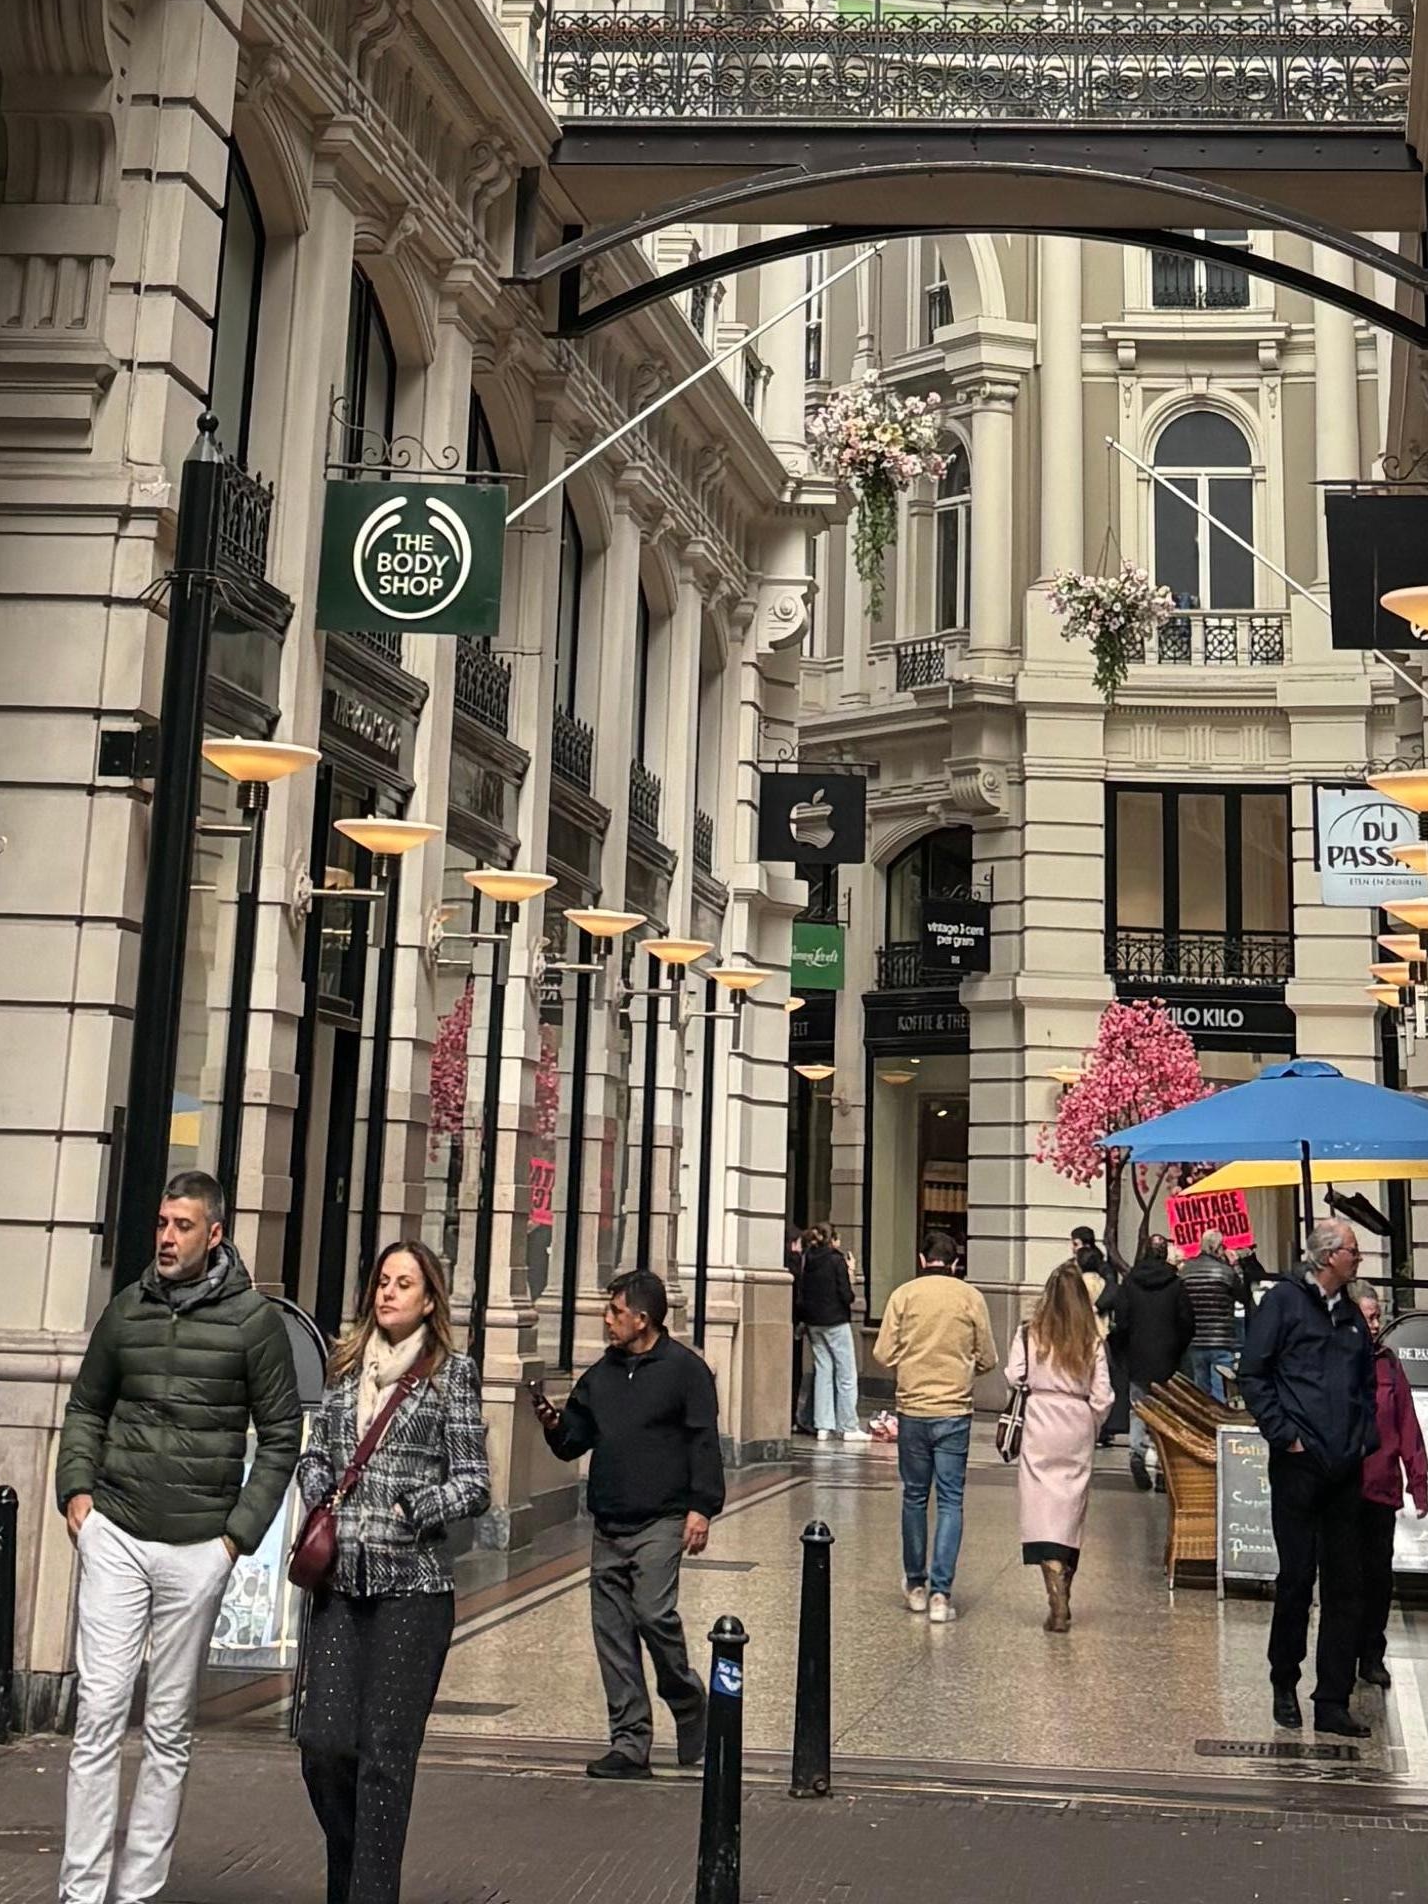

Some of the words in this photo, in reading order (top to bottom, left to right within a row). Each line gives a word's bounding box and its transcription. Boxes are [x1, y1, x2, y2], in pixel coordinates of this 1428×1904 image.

[393, 534, 434, 552] THE
[377, 553, 450, 576] BODY
[379, 576, 444, 596] SHOP
[1363, 822, 1398, 842] DU
[1327, 845, 1410, 869] PASS
[1203, 1008, 1244, 1028] KILO
[1174, 1191, 1241, 1223] VINTAGE
